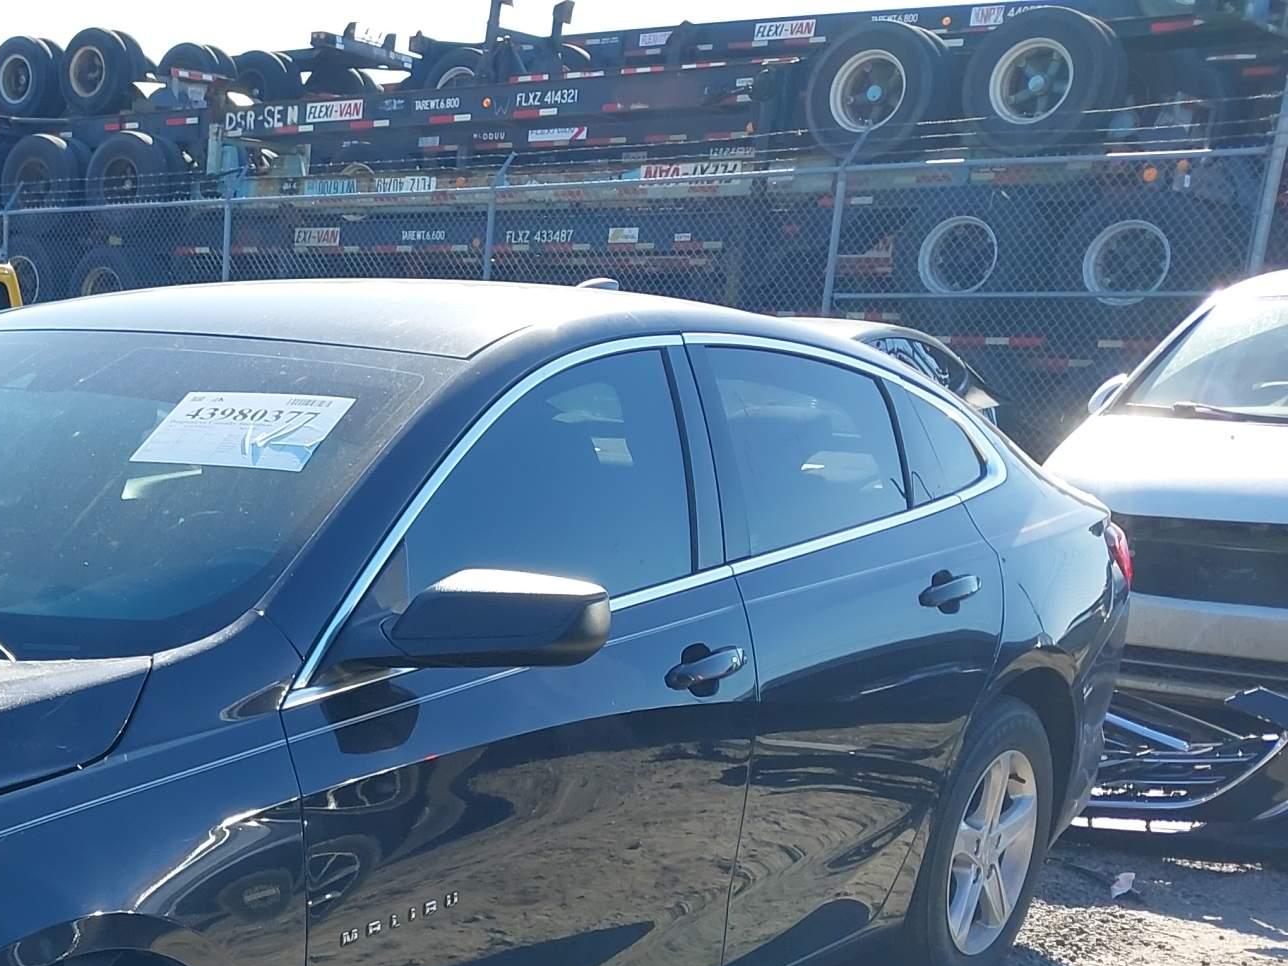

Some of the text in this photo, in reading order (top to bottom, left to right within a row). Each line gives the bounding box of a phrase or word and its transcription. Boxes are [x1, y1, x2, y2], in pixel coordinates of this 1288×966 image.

[755, 21, 813, 38] FLEXI-VAN
[516, 89, 578, 107] FLXZ 414321
[307, 102, 361, 121] FLEXI-VAN
[506, 229, 573, 243] FLXZ 433487
[186, 407, 320, 424] 43980377
